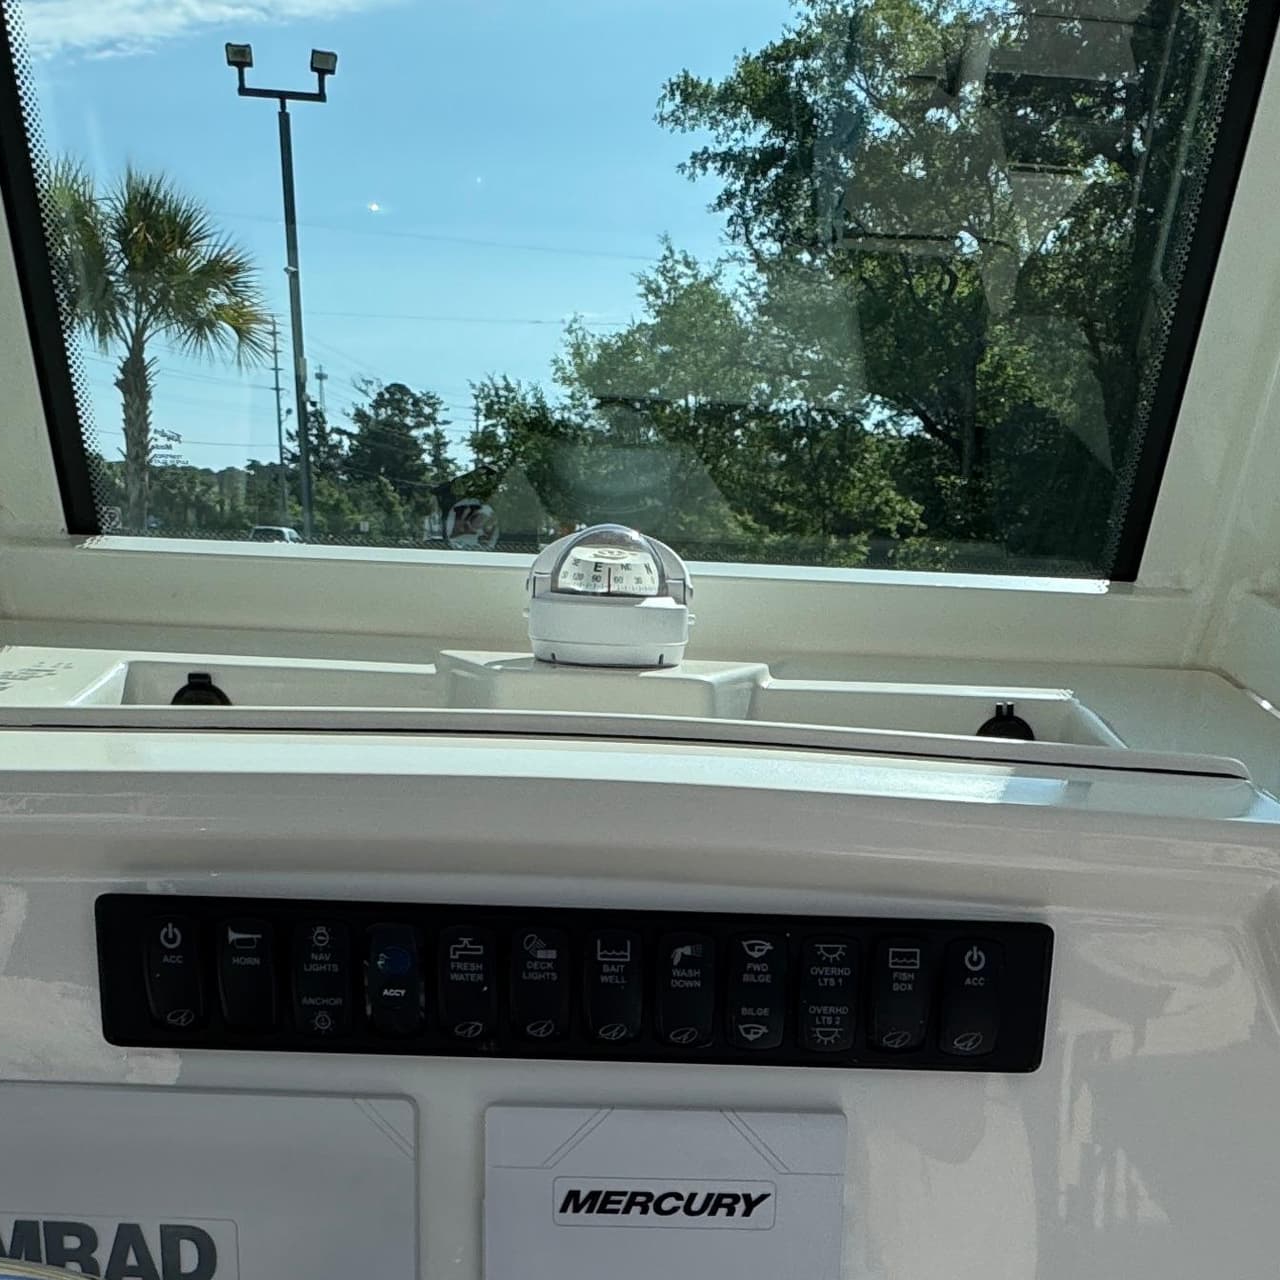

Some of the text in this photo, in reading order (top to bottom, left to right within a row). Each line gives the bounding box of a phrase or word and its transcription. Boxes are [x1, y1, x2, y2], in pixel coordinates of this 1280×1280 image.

[593, 562, 603, 572] E
[162, 955, 183, 965] ACC
[231, 956, 261, 967] HORN
[311, 952, 331, 961] NAV
[303, 963, 340, 972] LIGHTS
[449, 961, 484, 972] FRESH
[526, 961, 554, 971] DECK
[601, 964, 625, 974] BAIT
[746, 963, 769, 972] FWD
[521, 971, 558, 981] LIGHTS
[671, 968, 701, 978] WASH
[809, 967, 852, 977] OVERHD
[892, 972, 915, 981] FISH
[449, 972, 484, 983] WATER
[600, 974, 627, 984] WELL
[741, 974, 772, 984] BILGE
[817, 977, 836, 987] LTS
[964, 977, 986, 986] ACC
[670, 978, 702, 988] DOWN
[892, 982, 914, 991] BOX
[301, 997, 343, 1007] ANCHOR
[740, 1007, 770, 1017] BILGE
[807, 1005, 849, 1015] OVERHD
[558, 1189, 772, 1218] MERCURY
